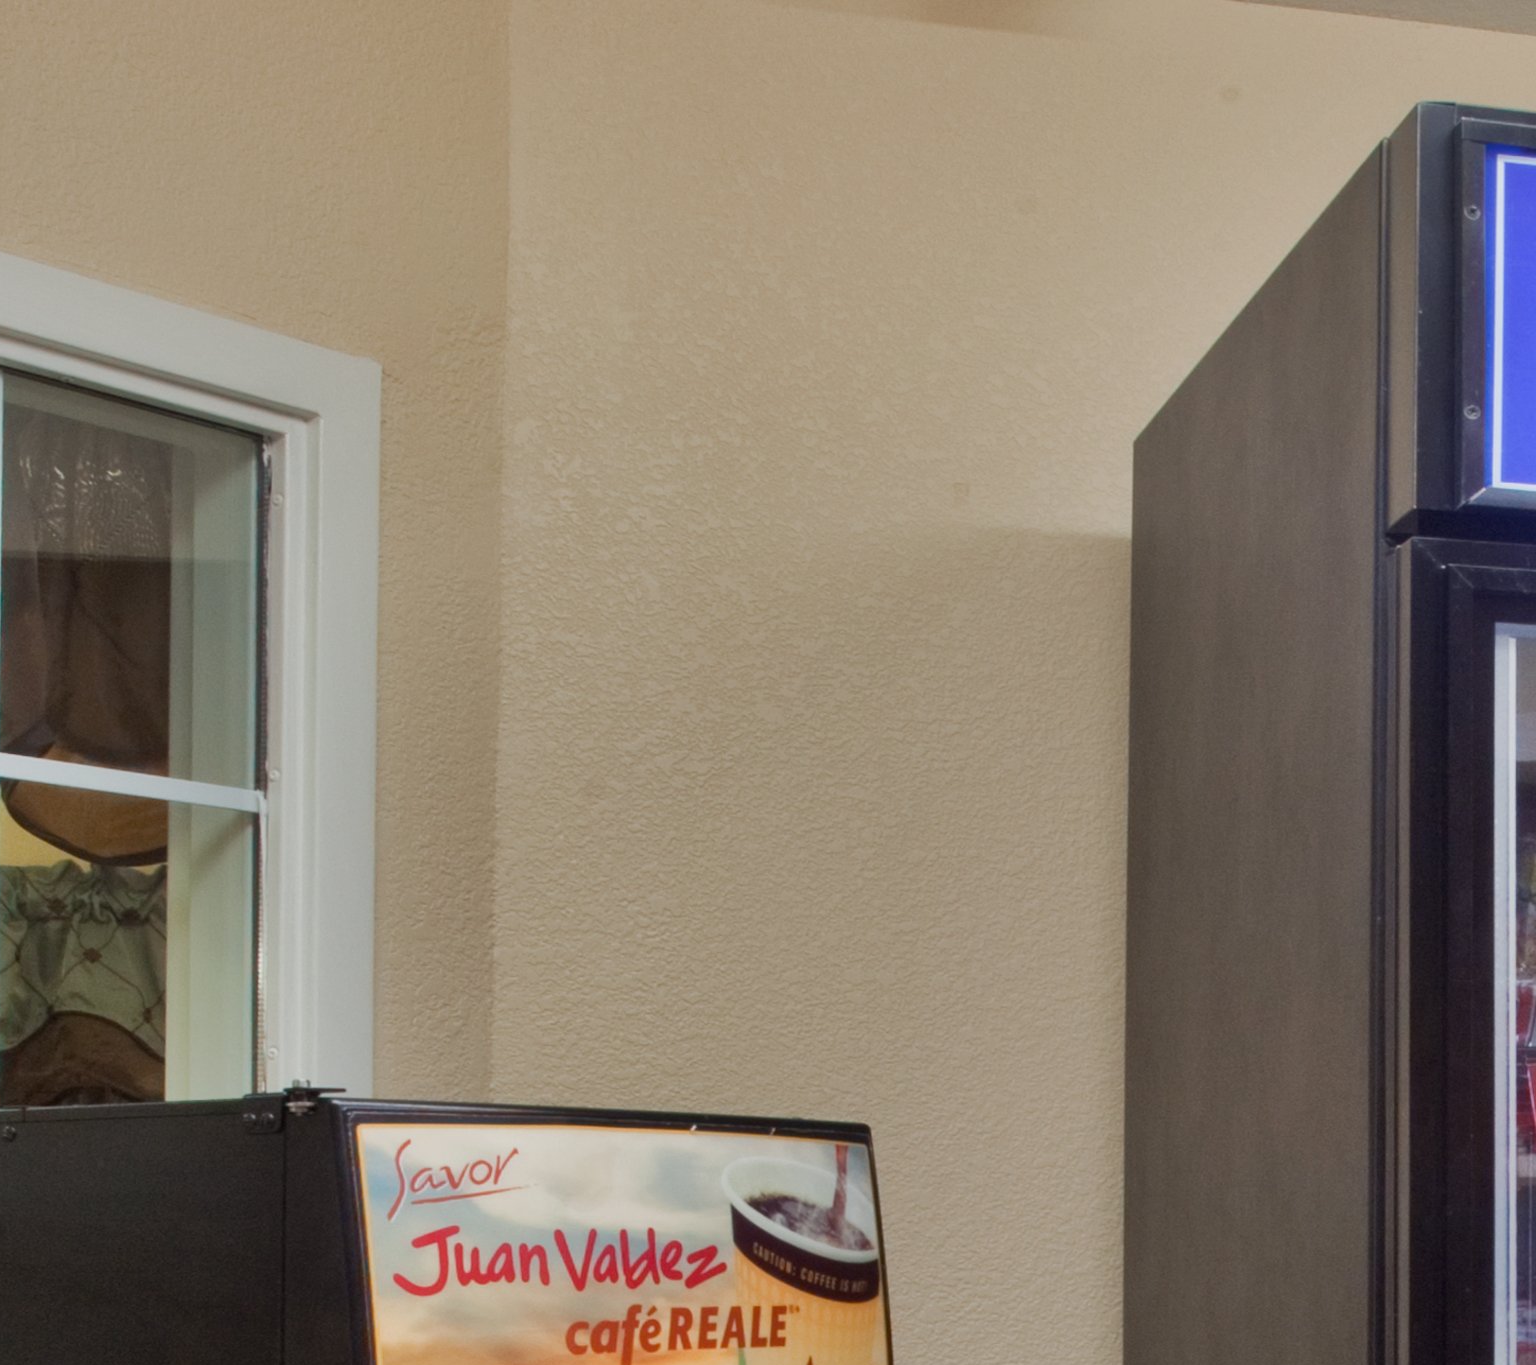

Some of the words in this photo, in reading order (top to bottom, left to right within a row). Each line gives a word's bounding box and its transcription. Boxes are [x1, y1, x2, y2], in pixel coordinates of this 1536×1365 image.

[387, 1139, 519, 1222] Savor
[393, 1225, 549, 1297] Juan
[554, 1226, 727, 1293] Valdez
[800, 1268, 836, 1290] COFFEE
